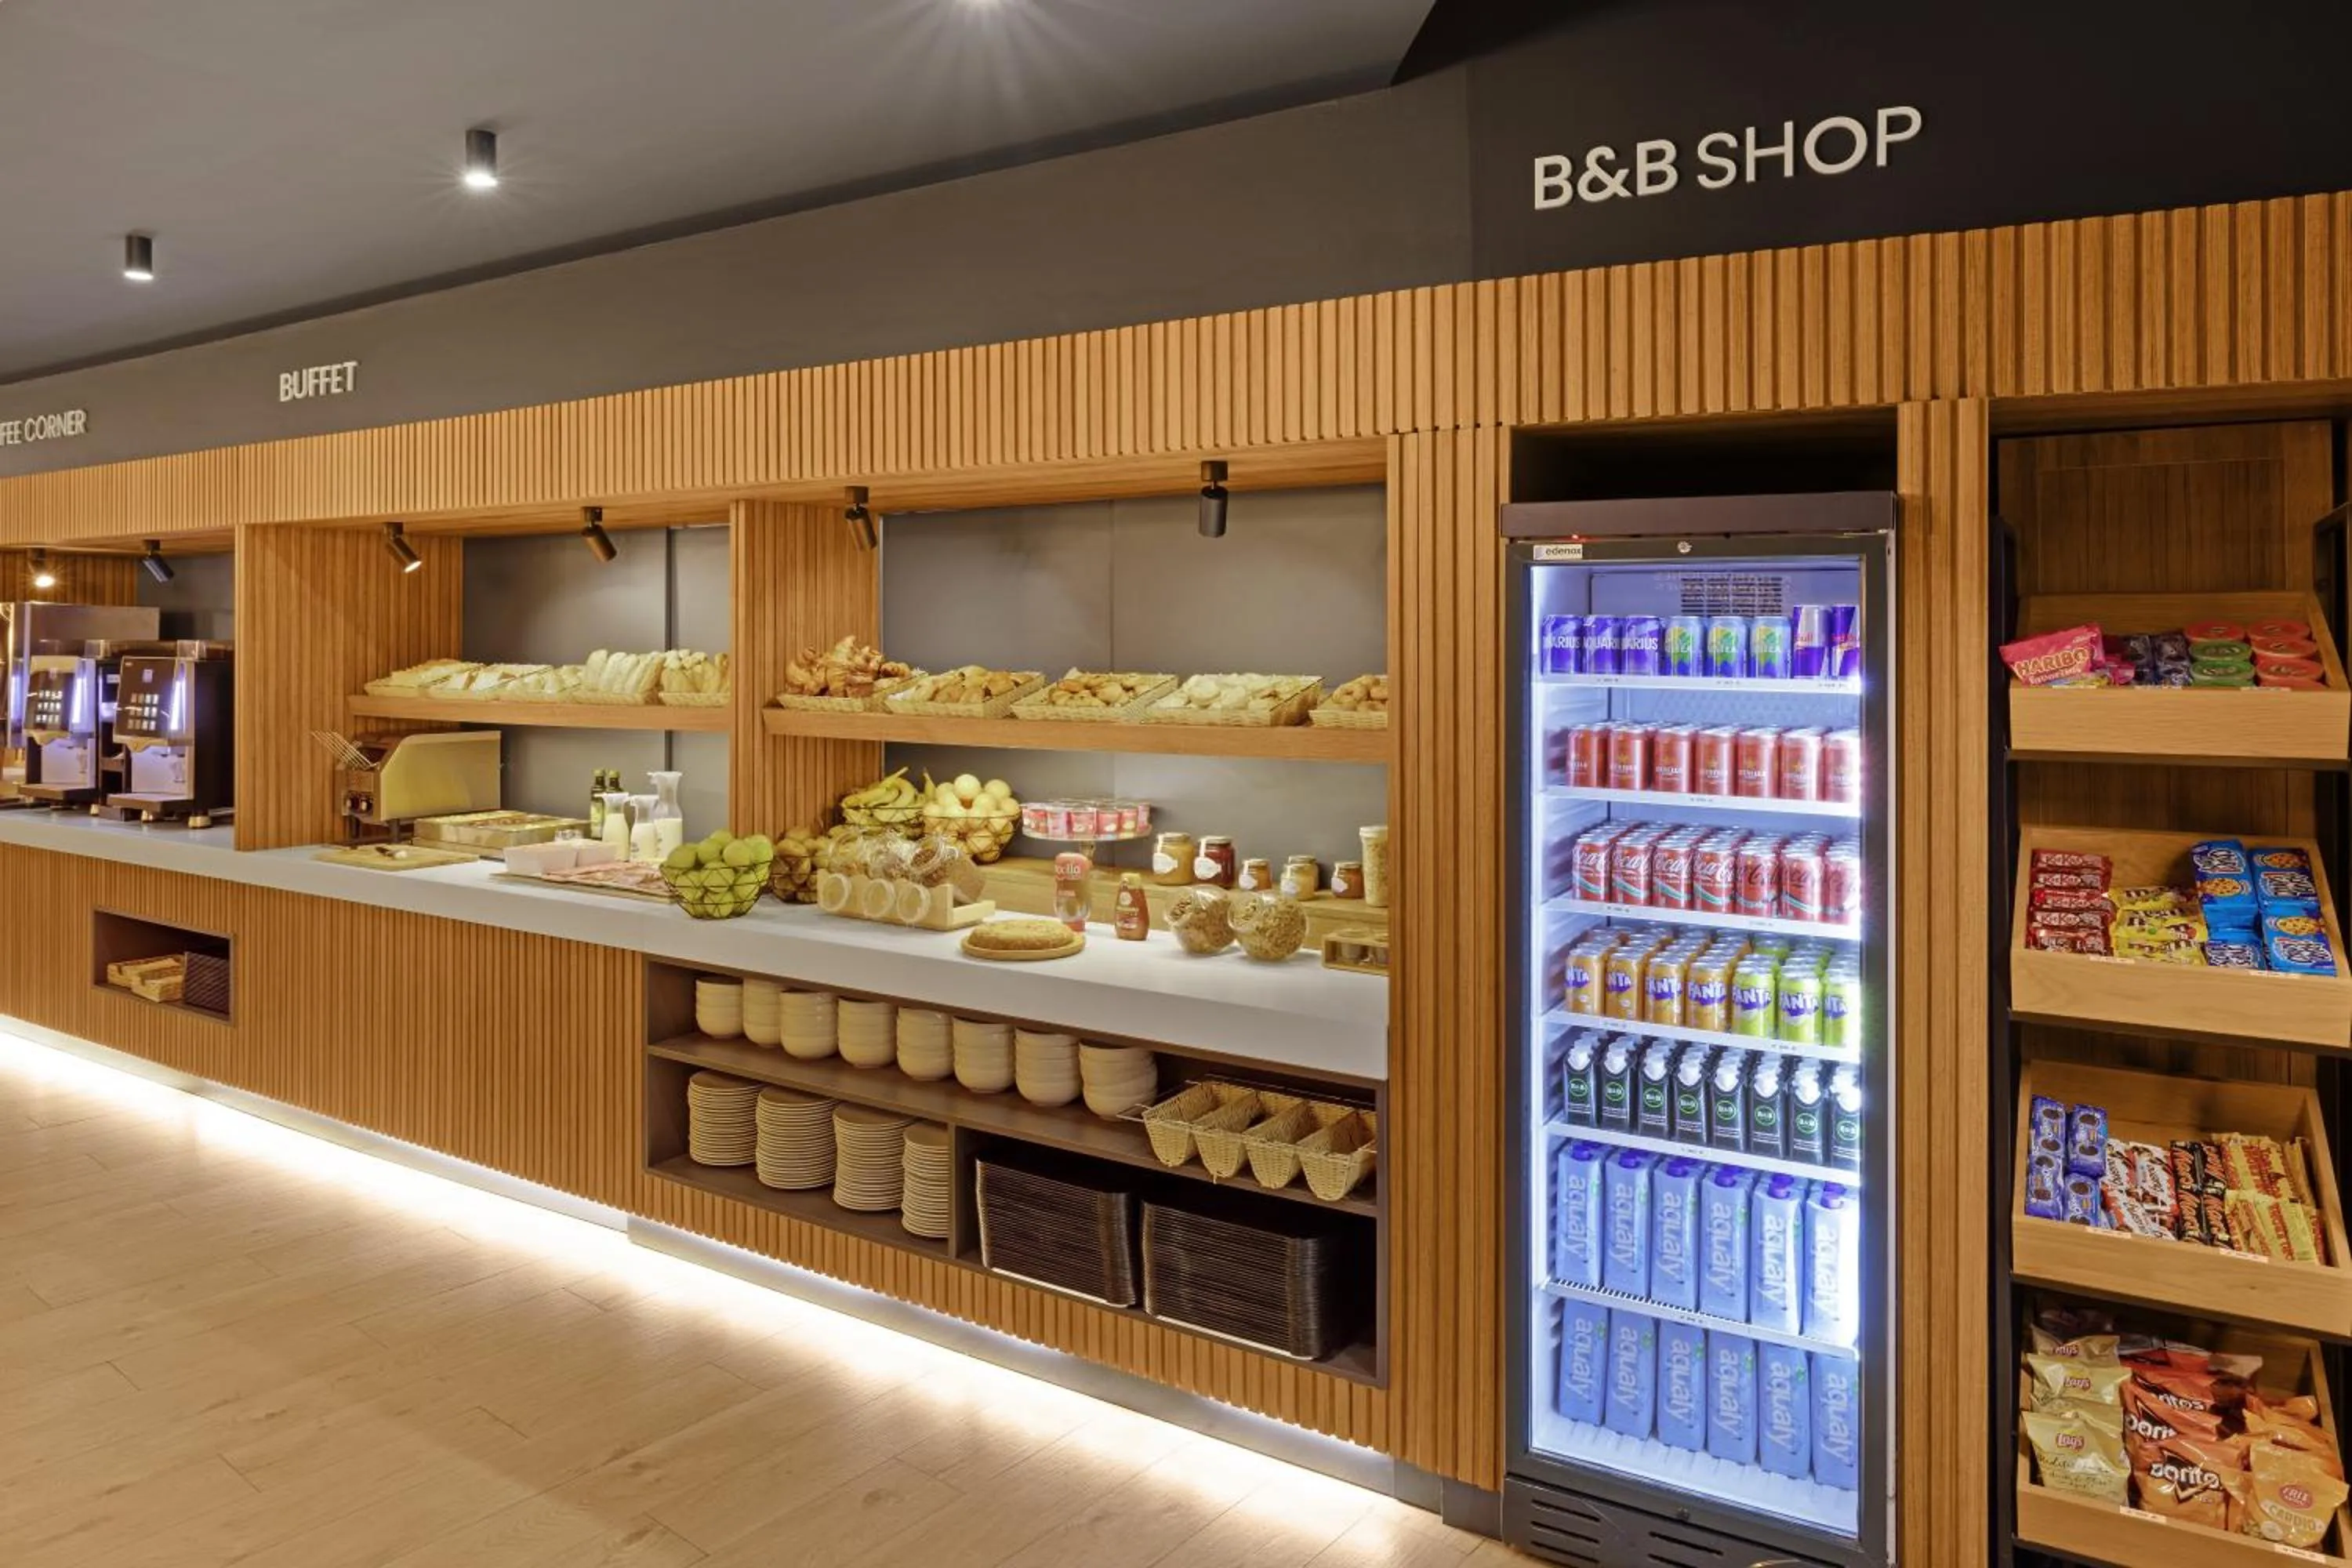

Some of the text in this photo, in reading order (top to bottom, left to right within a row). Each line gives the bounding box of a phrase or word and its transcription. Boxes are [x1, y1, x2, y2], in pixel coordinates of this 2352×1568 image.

[1534, 106, 1922, 210] B&B SHOP
[280, 361, 358, 402] BUFFET
[0, 409, 86, 445] FEE CORNER
[2015, 648, 2089, 676] HARIBO
[1562, 1175, 1588, 1258] aqualy
[1609, 1183, 1635, 1269] aqualy
[1656, 1192, 1685, 1282] aqualy
[1706, 1203, 1736, 1294] aqualy
[1756, 1215, 1787, 1305] aqualy
[1565, 1318, 1594, 1399] aqualy
[1612, 1327, 1639, 1410] aqualy
[1664, 1338, 1694, 1424] aqualy
[1711, 1348, 1743, 1436] aqualy
[1766, 1362, 1797, 1450] aqualy
[1820, 1373, 1854, 1462] aqualy
